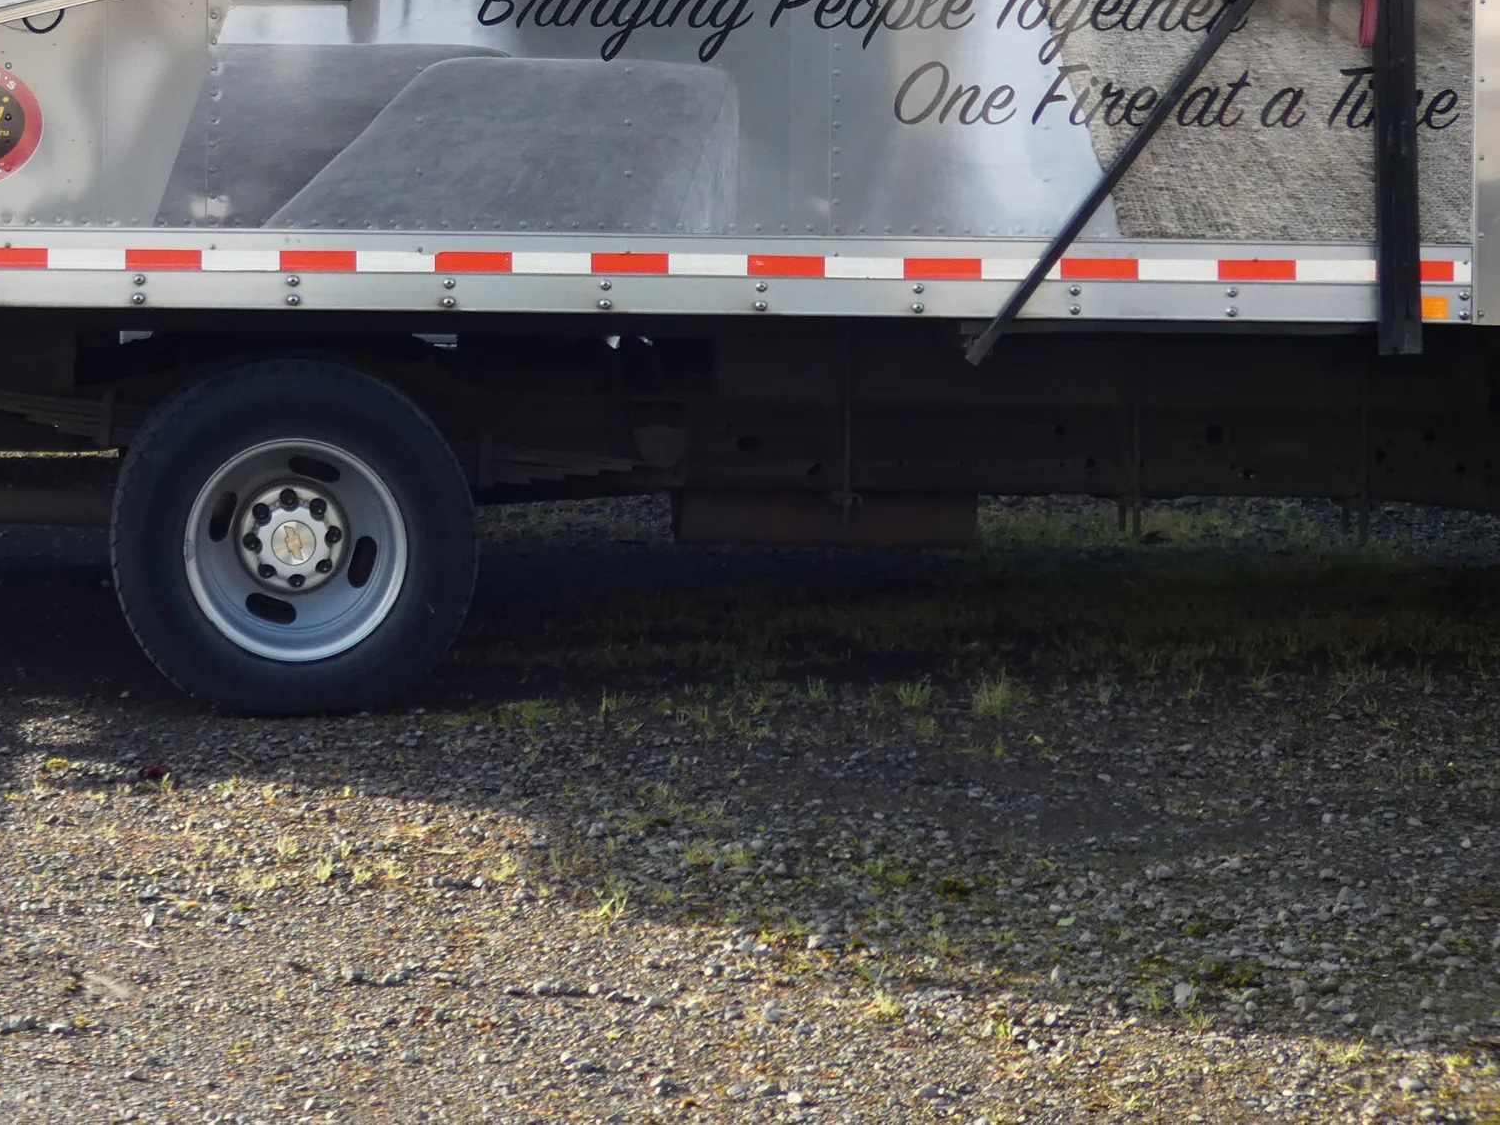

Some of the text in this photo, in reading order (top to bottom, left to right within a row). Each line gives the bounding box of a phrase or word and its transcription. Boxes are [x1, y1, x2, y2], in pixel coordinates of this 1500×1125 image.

[893, 60, 1461, 130] One Fire at a Tie
